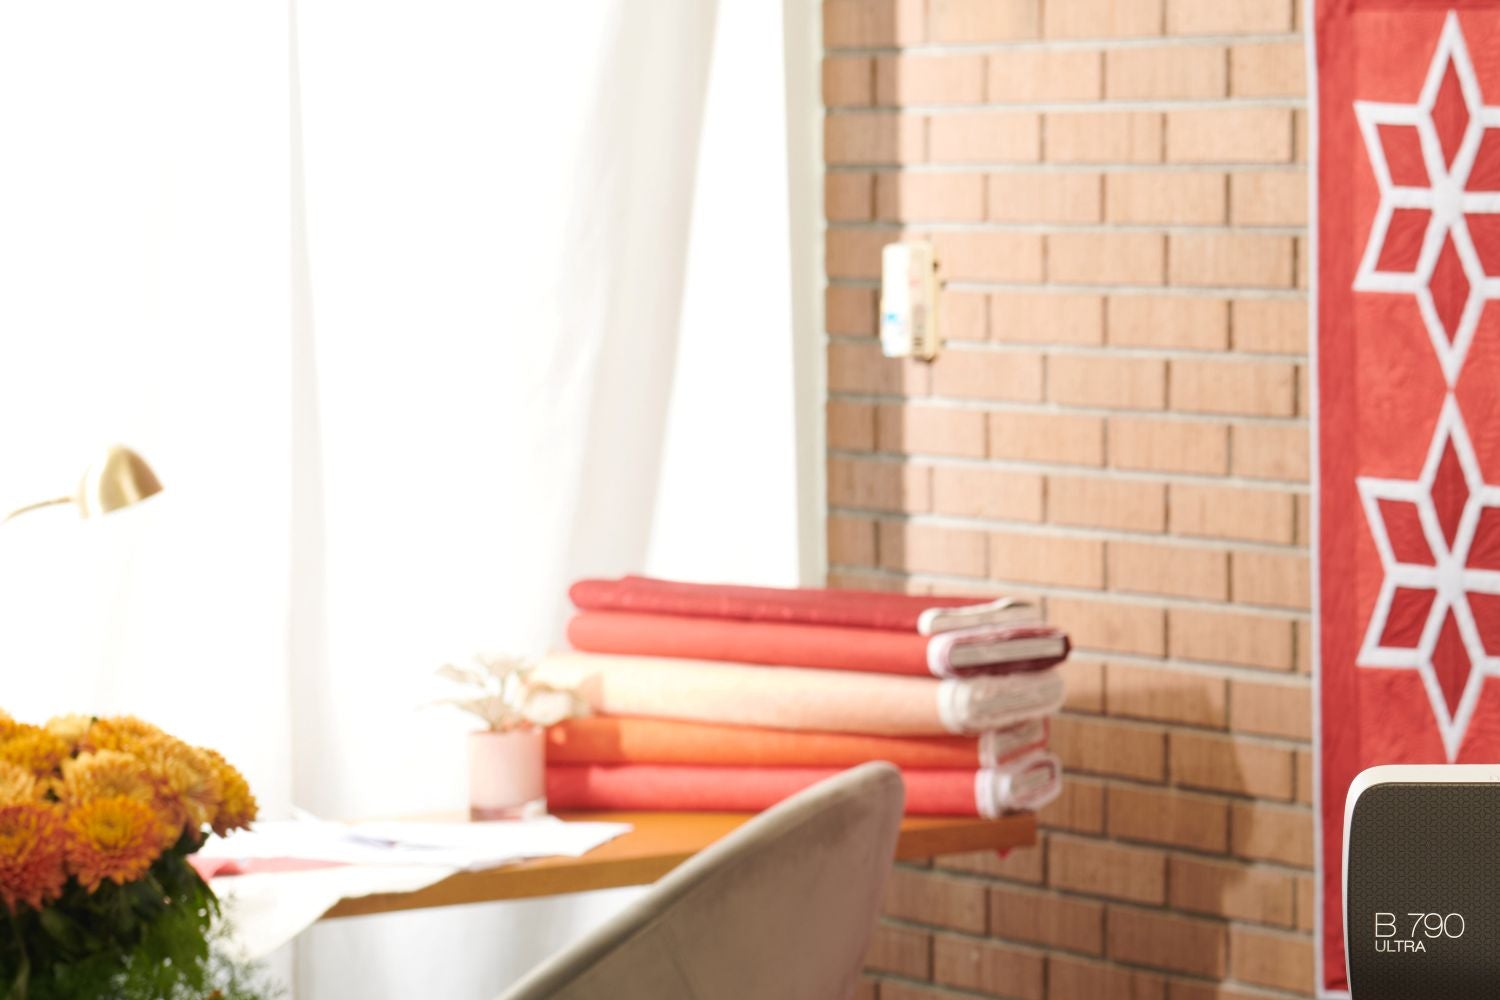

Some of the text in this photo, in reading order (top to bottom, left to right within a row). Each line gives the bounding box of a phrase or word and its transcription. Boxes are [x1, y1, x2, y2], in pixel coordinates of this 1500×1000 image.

[1375, 912, 1465, 939] B 790
[1375, 940, 1427, 953] ULTRA
